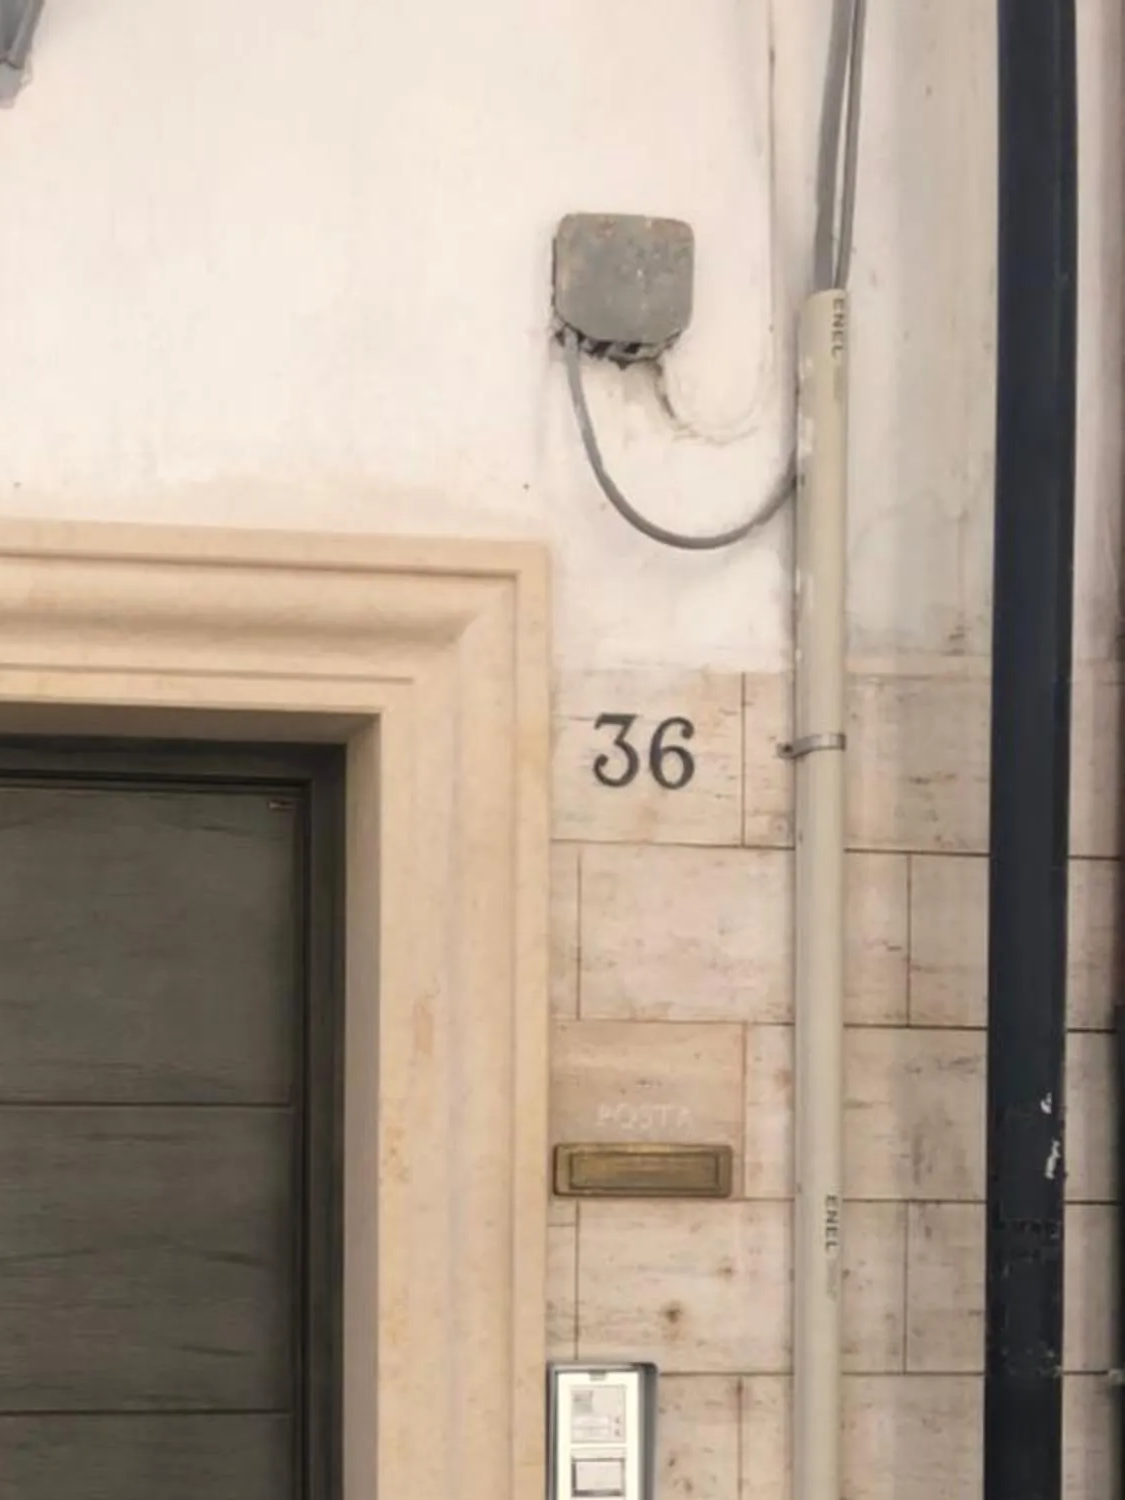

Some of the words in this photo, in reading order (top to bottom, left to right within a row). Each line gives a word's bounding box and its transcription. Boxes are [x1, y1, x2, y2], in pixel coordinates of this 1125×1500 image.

[831, 298, 845, 359] ENEL
[593, 712, 695, 790] 36
[596, 1101, 695, 1130] POSTA
[825, 1193, 838, 1253] ENEL
